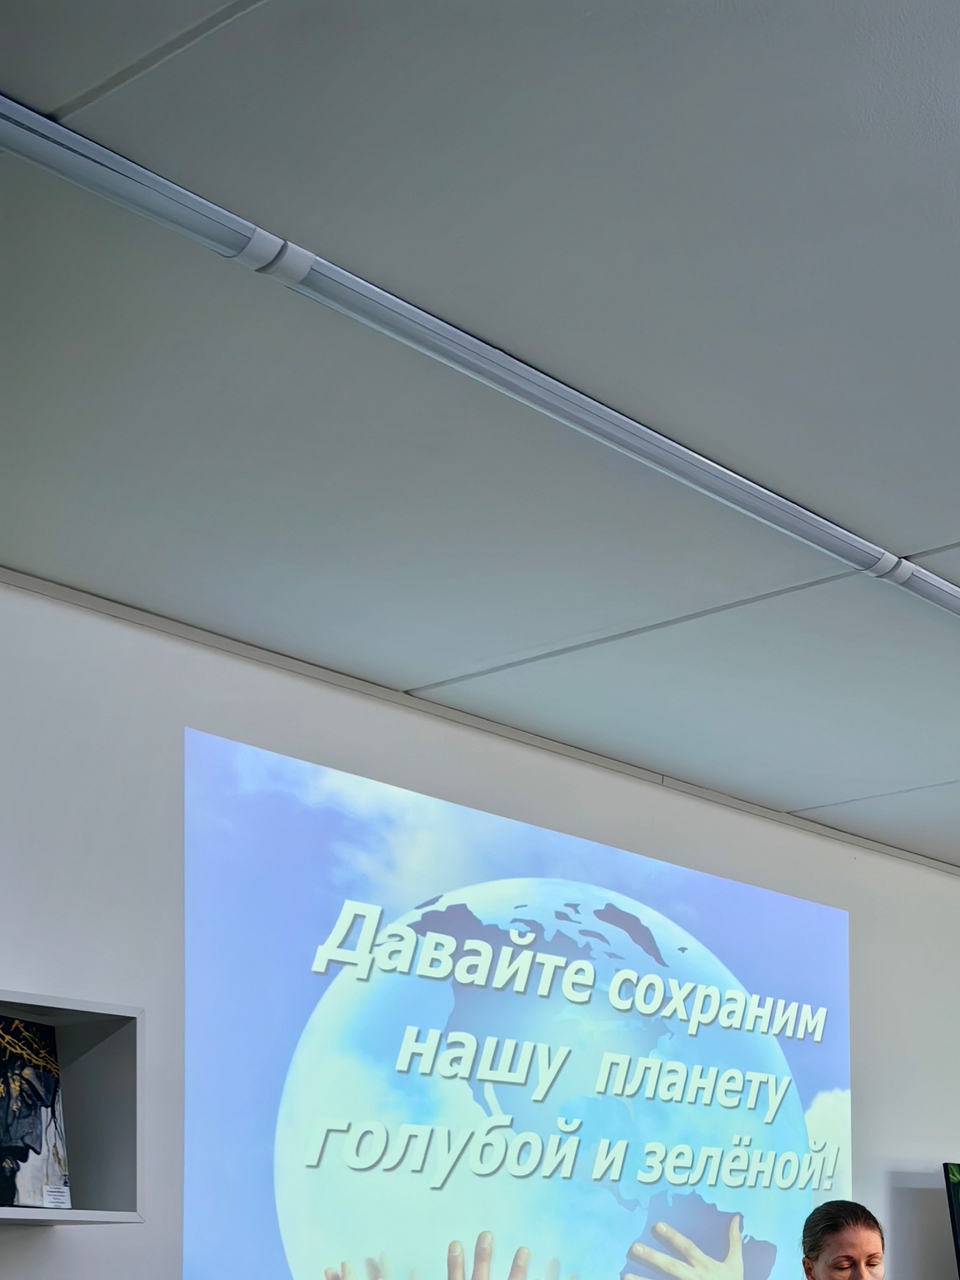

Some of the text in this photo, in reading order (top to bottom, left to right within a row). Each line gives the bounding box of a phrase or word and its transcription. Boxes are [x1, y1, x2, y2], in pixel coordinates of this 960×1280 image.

[310, 898, 828, 1042] Давайте сохраним
[395, 1024, 792, 1124] нашу планету
[305, 1114, 840, 1191] голубой и зелёной!
